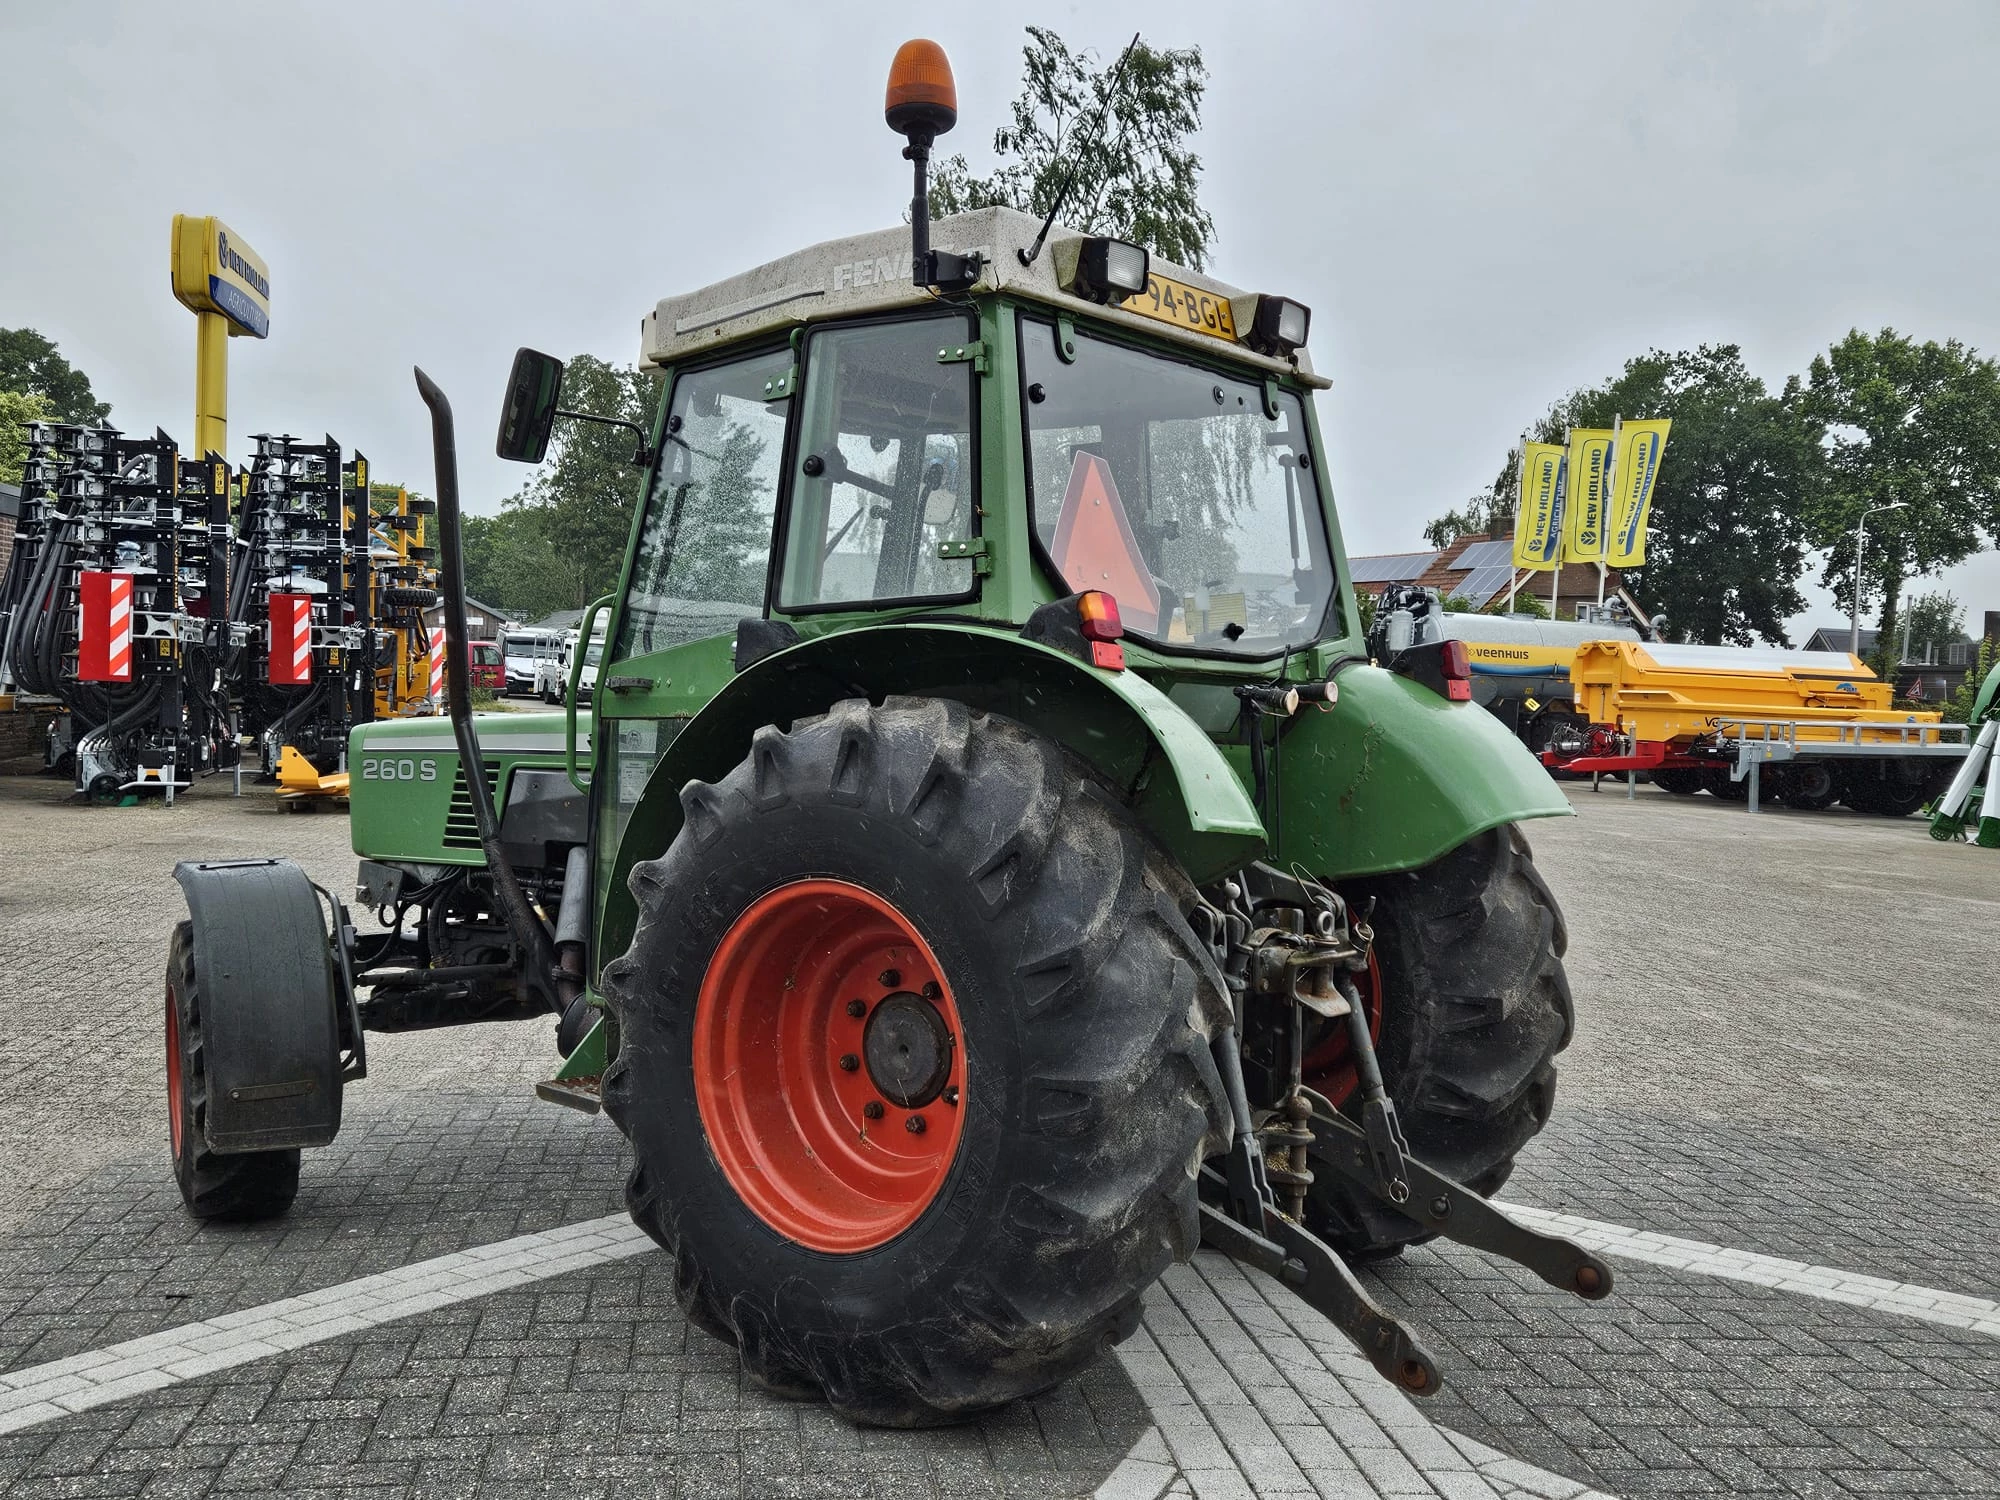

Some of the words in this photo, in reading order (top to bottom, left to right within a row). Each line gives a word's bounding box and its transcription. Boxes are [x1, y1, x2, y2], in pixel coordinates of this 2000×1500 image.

[1131, 278, 1232, 335] 94-BGL
[1539, 460, 1553, 510] HOLLAND
[1588, 449, 1602, 501] HOLLAND
[1632, 442, 1647, 499] HOLLAND
[1536, 511, 1547, 536] NEW
[1586, 503, 1597, 528] NEW
[362, 758, 415, 780] 260
[420, 759, 437, 781] S
